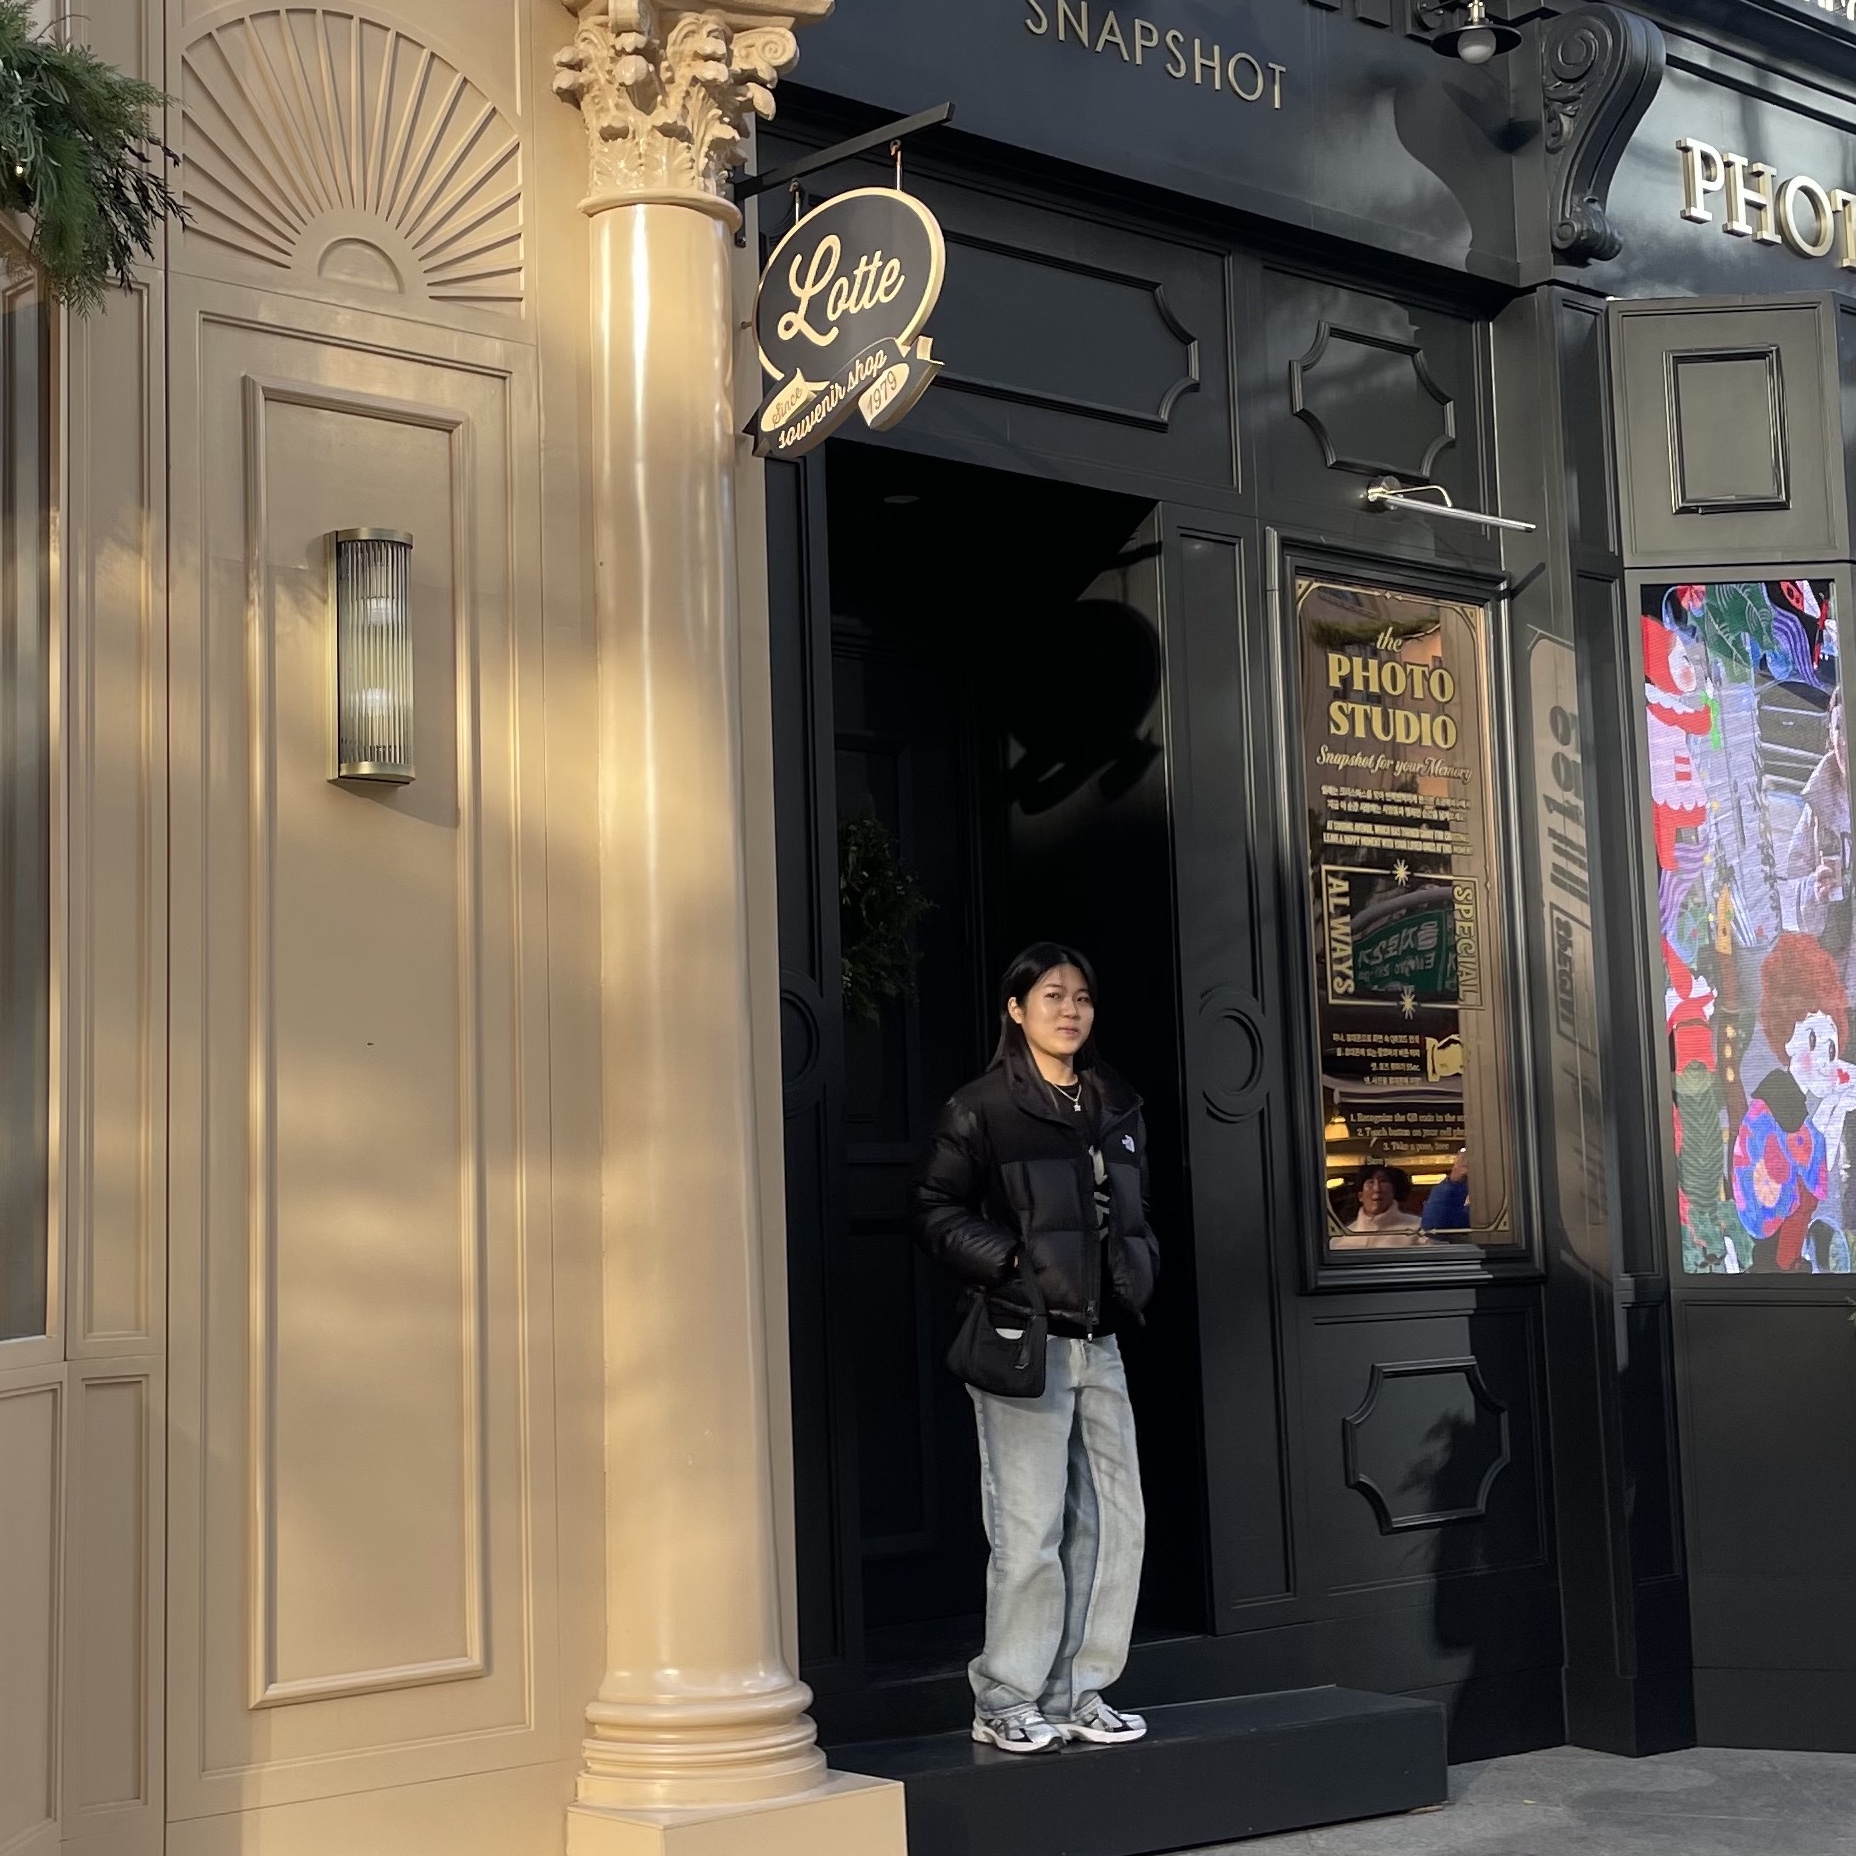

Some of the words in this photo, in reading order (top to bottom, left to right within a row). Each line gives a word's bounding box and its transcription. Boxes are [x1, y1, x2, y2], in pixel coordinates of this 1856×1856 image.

[1025, 0, 1287, 110] SNAPSHOT
[777, 233, 906, 347] Lotte
[772, 386, 803, 427] Since
[778, 380, 847, 450] souvenir
[846, 349, 888, 394] shop
[866, 369, 899, 416] 1979
[1375, 626, 1403, 652] the
[1327, 652, 1455, 703] PHOTO
[1329, 700, 1457, 750] STUDIO
[1316, 744, 1375, 771] Snapshot
[1371, 753, 1394, 773] for
[1393, 760, 1424, 777] your
[1420, 756, 1473, 785] Memory
[1327, 874, 1355, 995] ALWAYS
[1453, 884, 1479, 1001] SPECIAL
